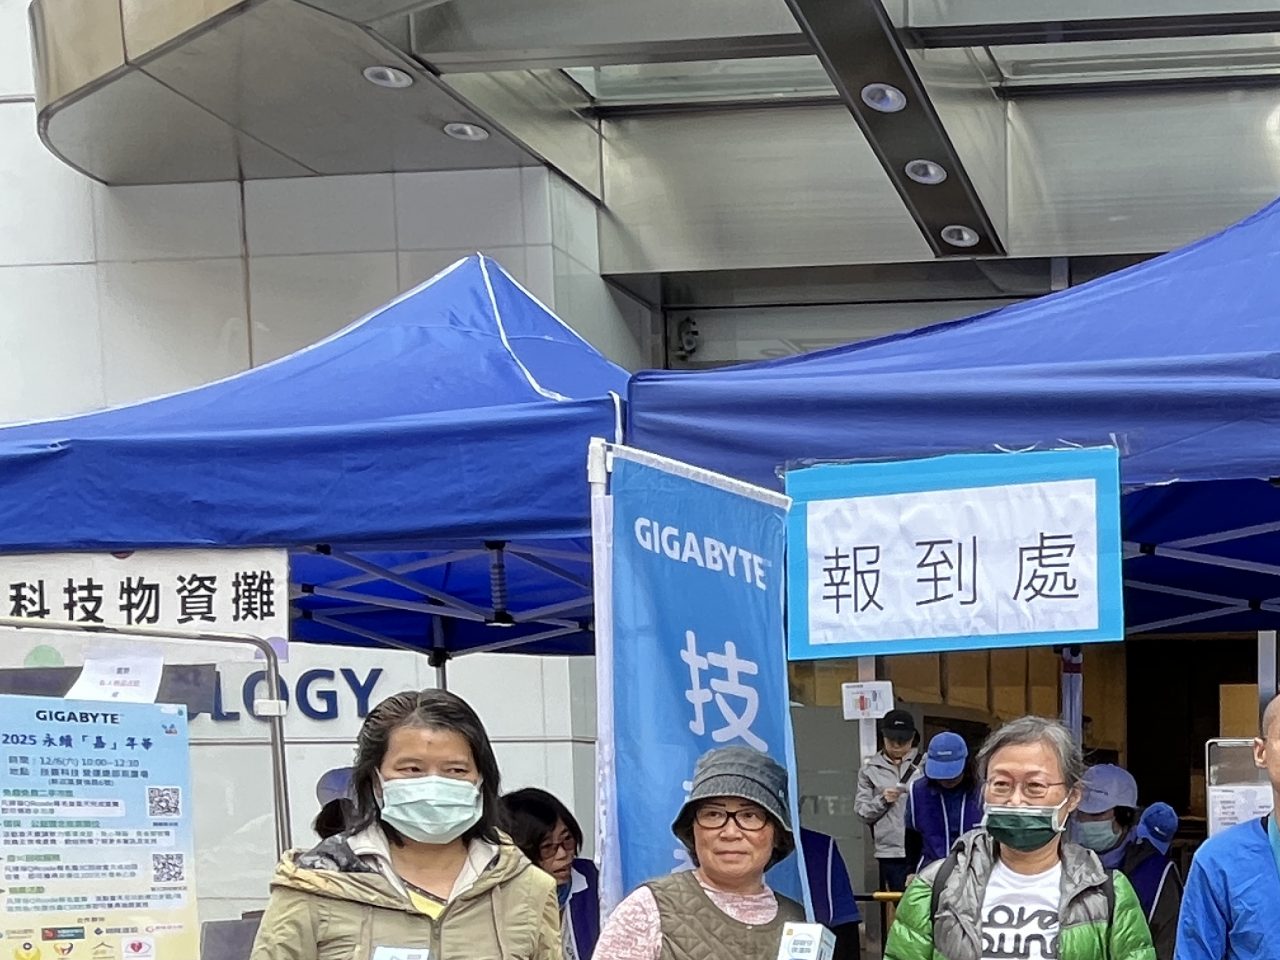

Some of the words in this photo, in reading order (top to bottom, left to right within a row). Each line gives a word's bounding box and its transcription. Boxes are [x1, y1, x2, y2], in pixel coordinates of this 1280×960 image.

[634, 517, 767, 590] GIGABYTE
[822, 532, 1080, 614] 報到處
[9, 570, 276, 625] 科技物資攤
[2, 733, 37, 746] 2025
[35, 710, 120, 724] GIGABYTE
